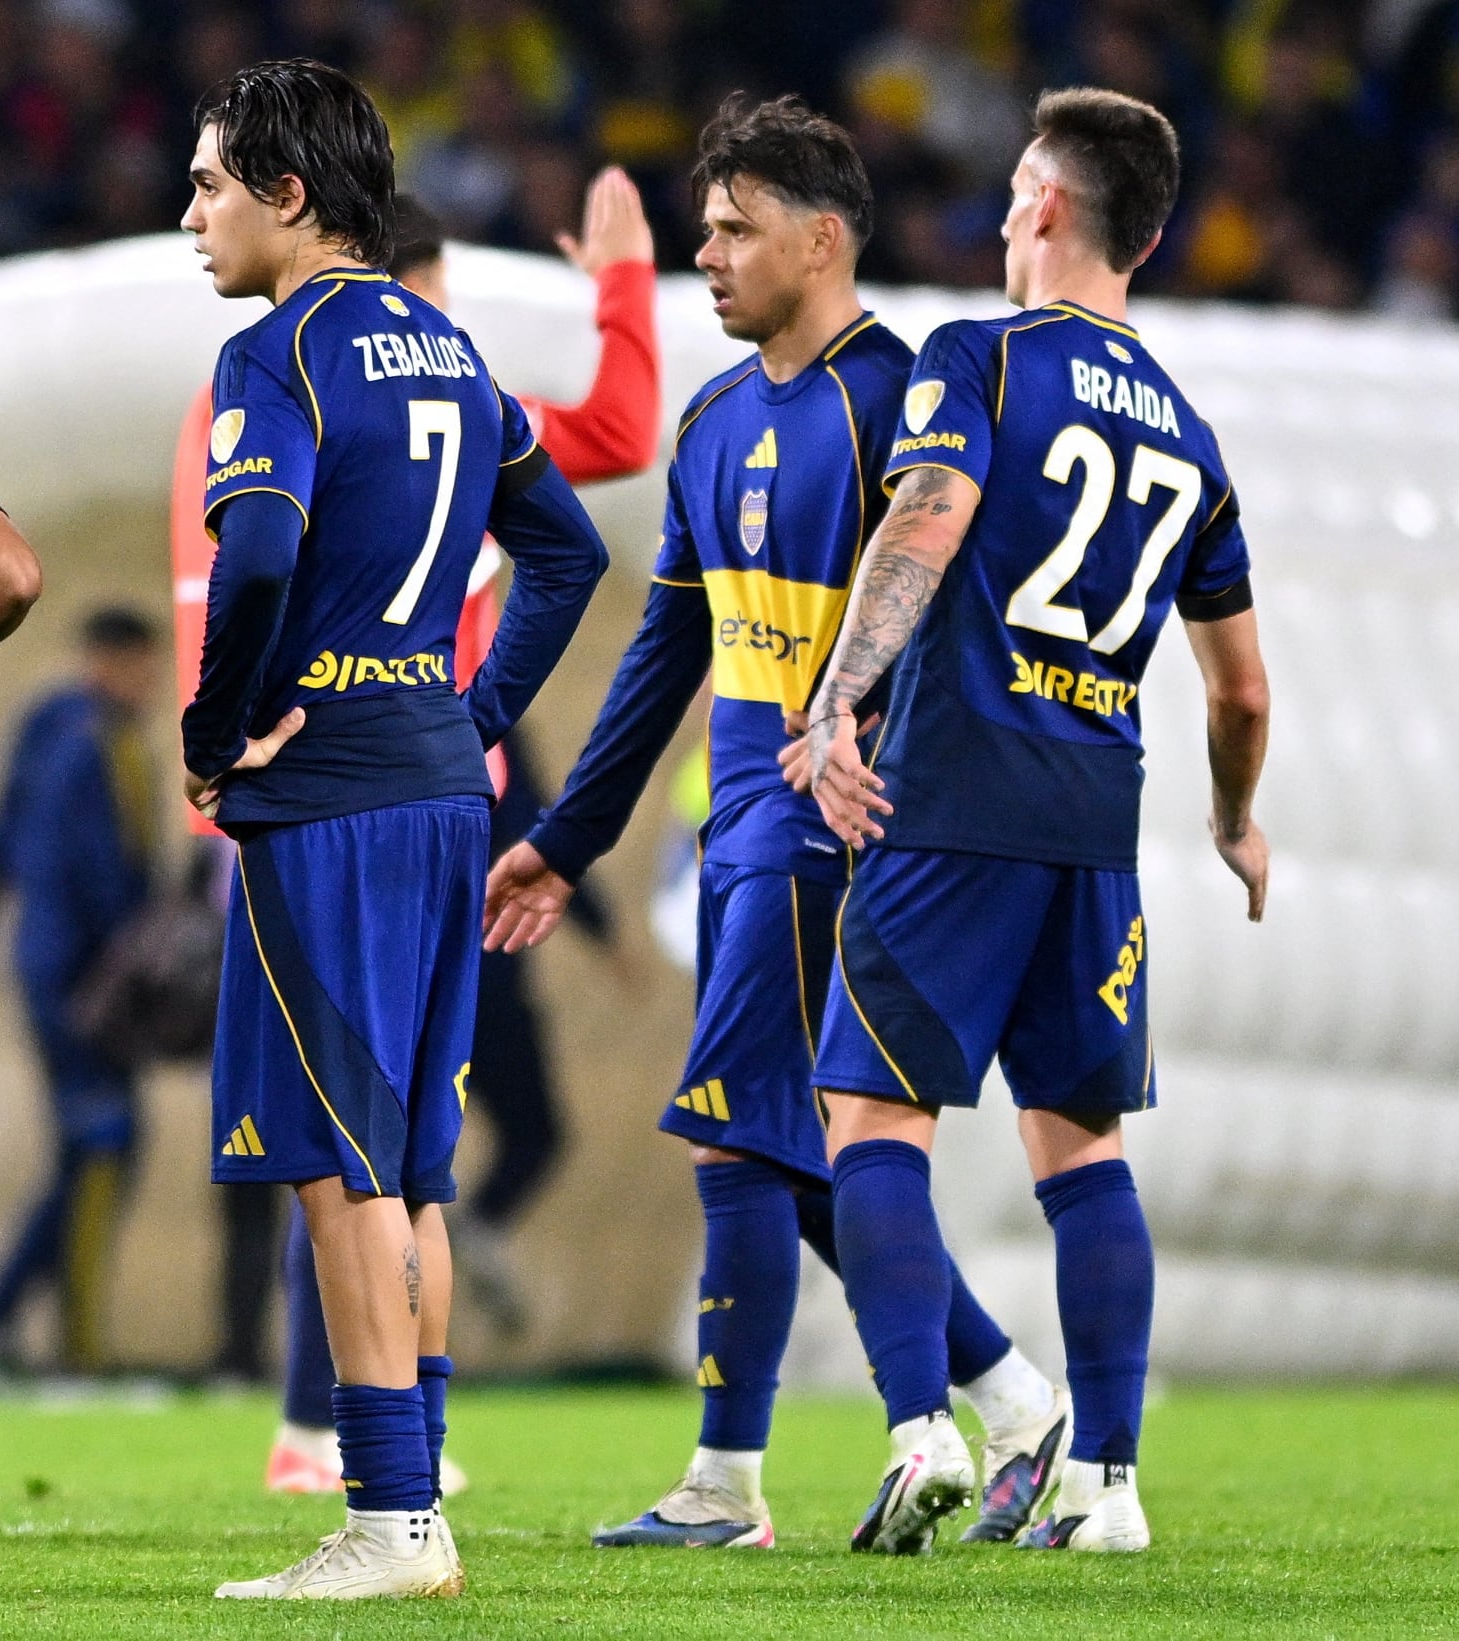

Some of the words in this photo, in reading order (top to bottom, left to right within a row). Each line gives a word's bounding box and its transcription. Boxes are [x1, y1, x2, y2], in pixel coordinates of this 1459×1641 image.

[352, 331, 477, 382] ZEBALLOS
[1070, 357, 1182, 439] BRAIDA
[381, 399, 462, 626] 7
[1005, 424, 1202, 656] 27
[1008, 651, 1138, 718] DIRECTV
